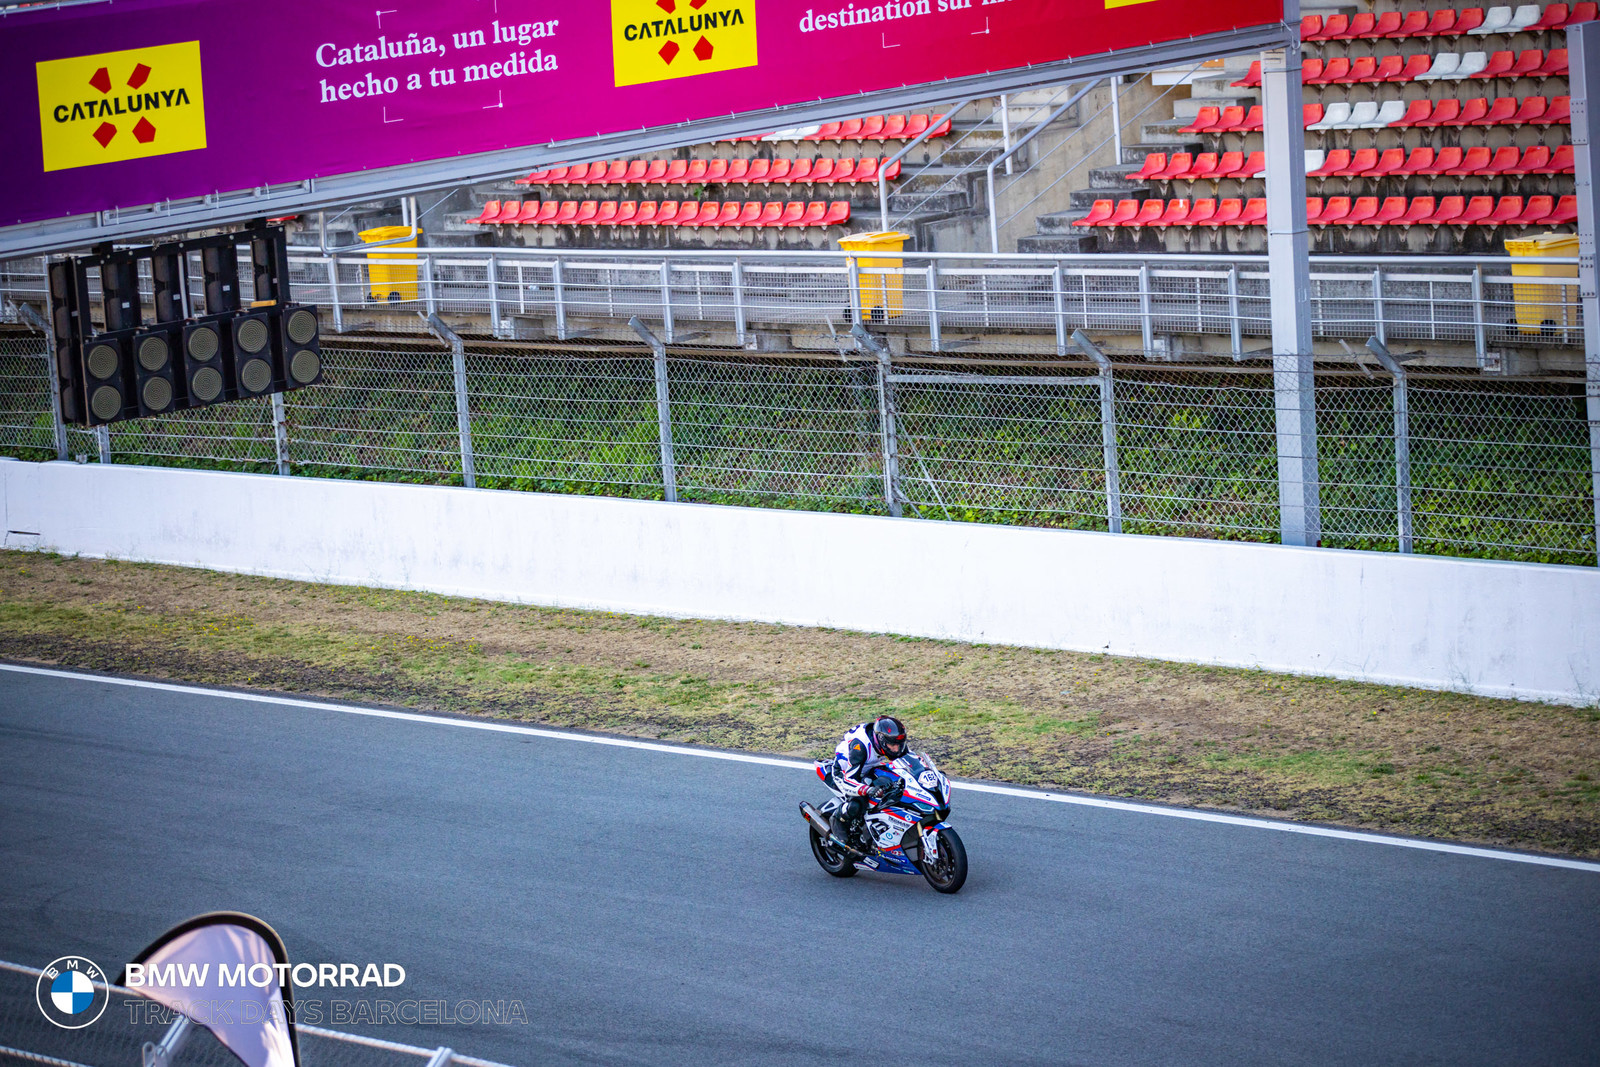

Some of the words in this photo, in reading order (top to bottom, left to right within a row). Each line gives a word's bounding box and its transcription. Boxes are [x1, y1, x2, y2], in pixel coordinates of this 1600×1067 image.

[624, 8, 744, 42] CATALUNYA
[799, 0, 932, 33] destination
[316, 32, 446, 68] Cataluña,
[452, 29, 486, 50] un
[492, 19, 559, 46] lugar
[319, 72, 399, 103] hecho
[406, 73, 422, 91] a
[429, 67, 456, 87] tu
[463, 49, 559, 83] medida
[53, 87, 190, 124] CATALUNYA
